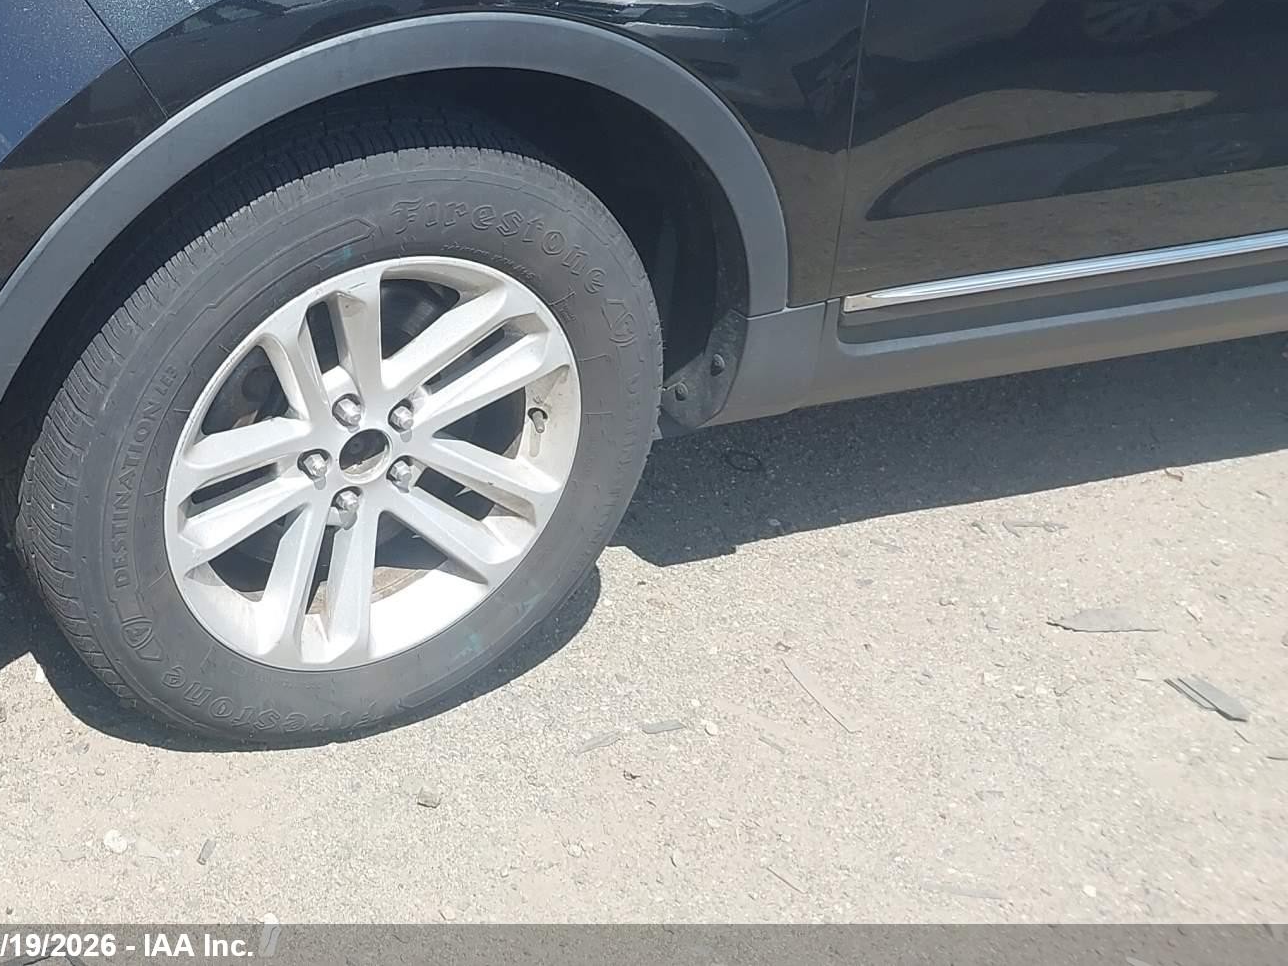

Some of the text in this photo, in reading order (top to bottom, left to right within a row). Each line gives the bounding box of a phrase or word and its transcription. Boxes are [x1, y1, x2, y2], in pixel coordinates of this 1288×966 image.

[390, 196, 608, 295] Firestone
[112, 400, 163, 589] DESTINATION
[162, 665, 386, 733] Firestone
